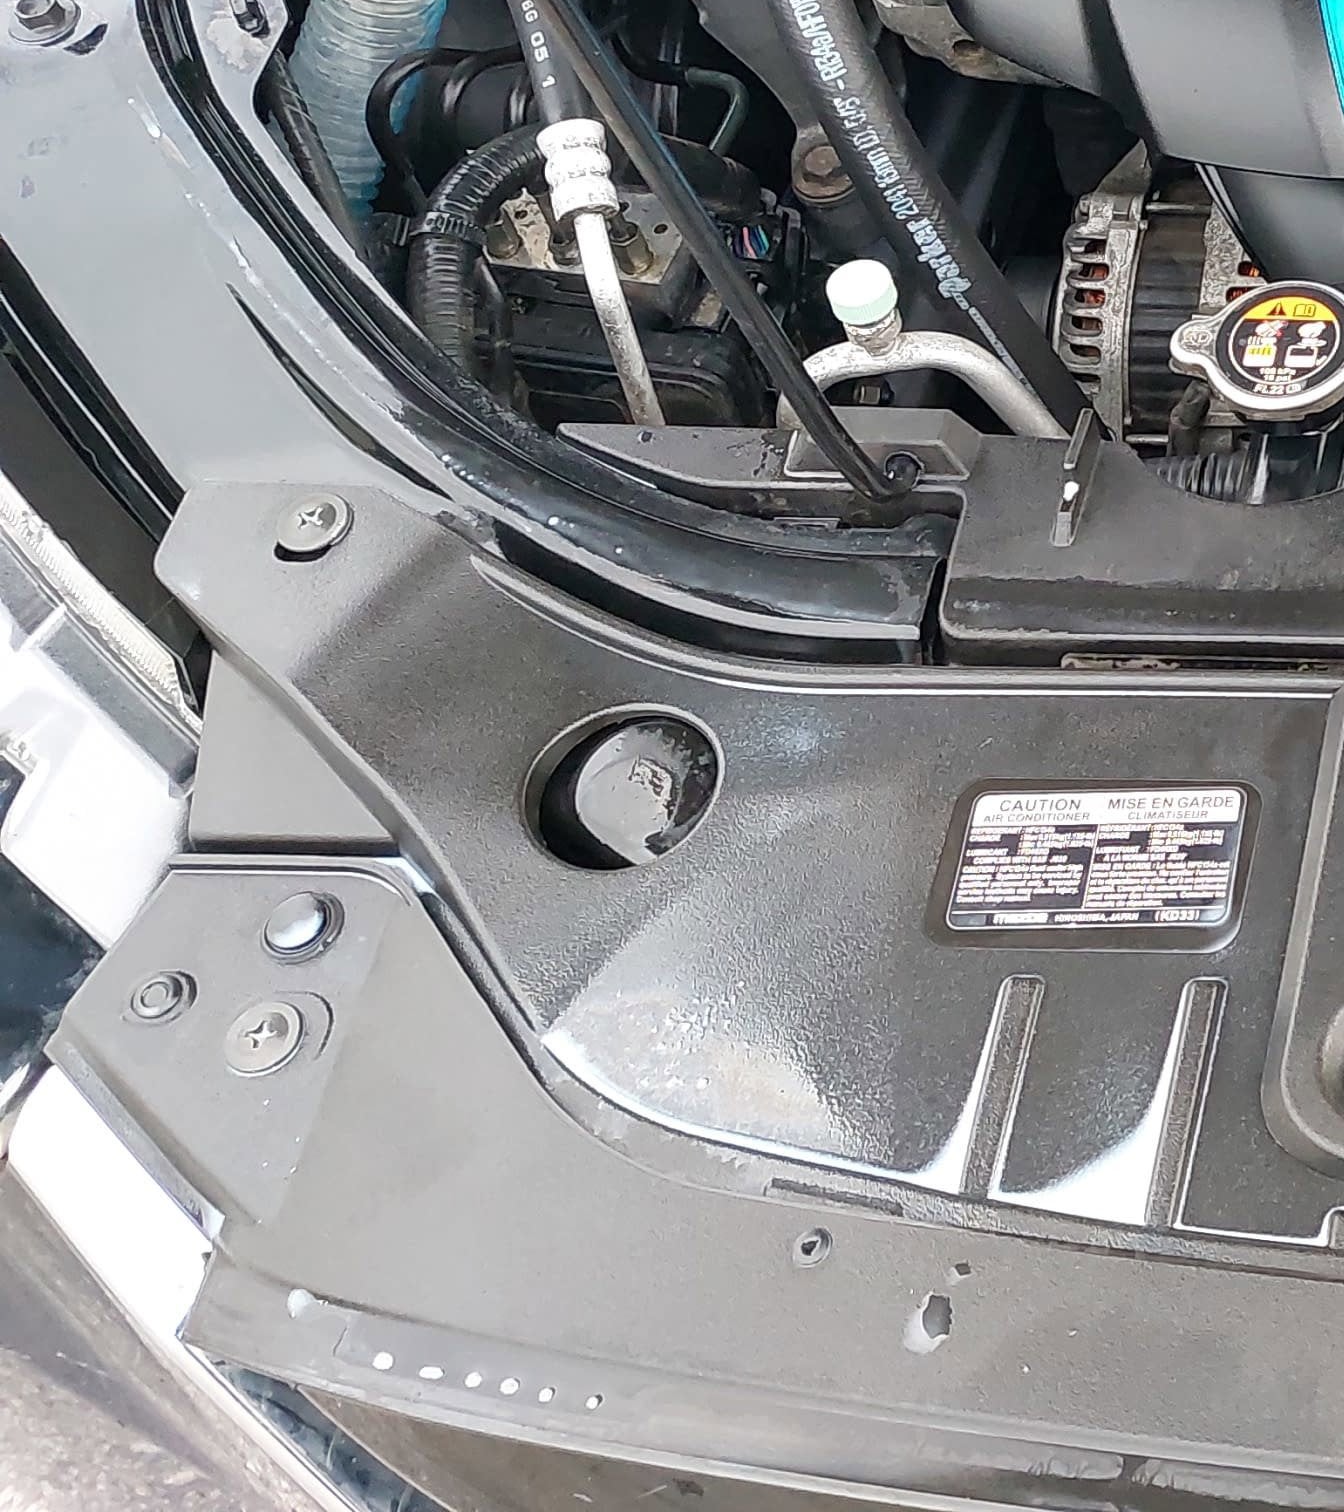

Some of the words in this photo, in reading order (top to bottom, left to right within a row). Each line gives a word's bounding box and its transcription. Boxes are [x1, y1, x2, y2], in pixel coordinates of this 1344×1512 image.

[906, 216, 972, 299] Parker
[998, 798, 1082, 813] CAUTION
[1108, 797, 1148, 810] MISE
[1151, 796, 1176, 809] EN
[1178, 795, 1235, 809] GARDE
[983, 813, 1004, 824] AIR
[1006, 811, 1091, 823] CONDITIONER
[1127, 809, 1209, 820] CLIMATISEUR
